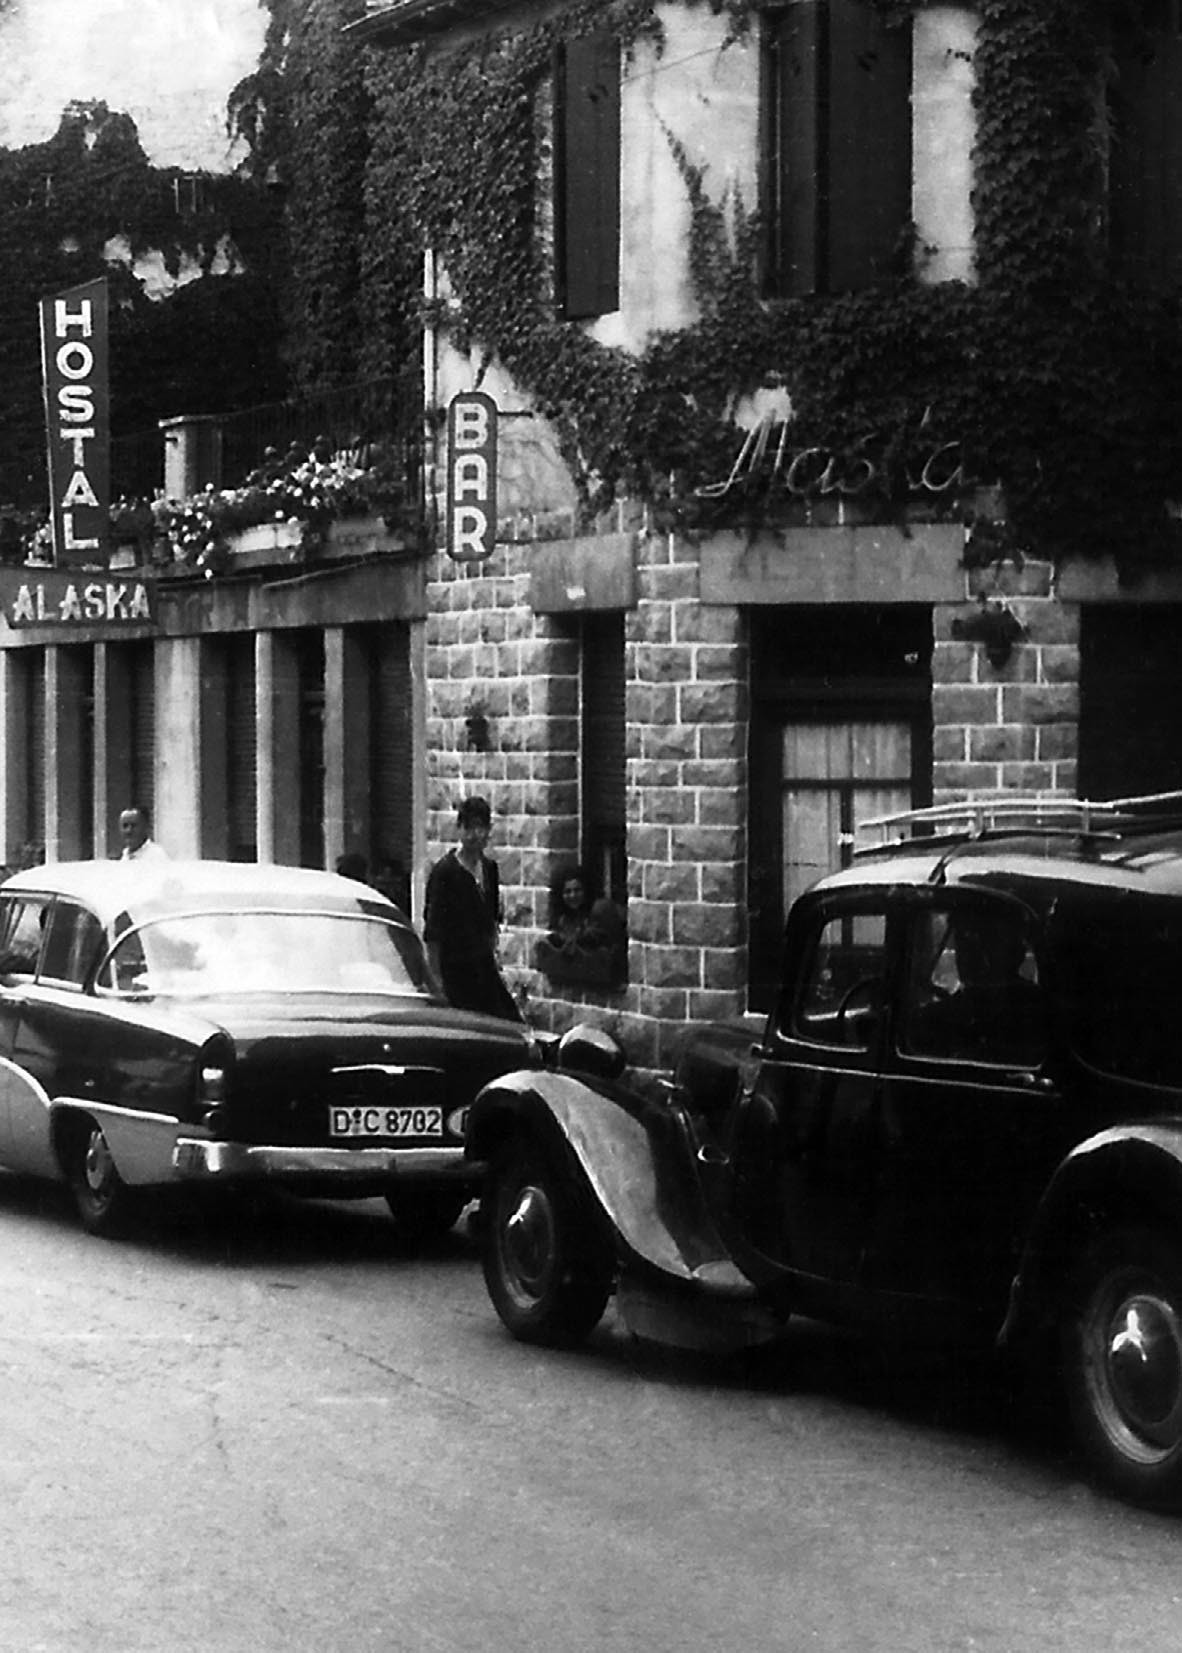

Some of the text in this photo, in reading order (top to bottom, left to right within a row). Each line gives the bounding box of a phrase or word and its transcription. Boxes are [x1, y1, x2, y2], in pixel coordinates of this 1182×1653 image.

[55, 299, 99, 550] HOSTAL
[454, 402, 489, 553] BAR
[12, 583, 151, 621] ALASKA
